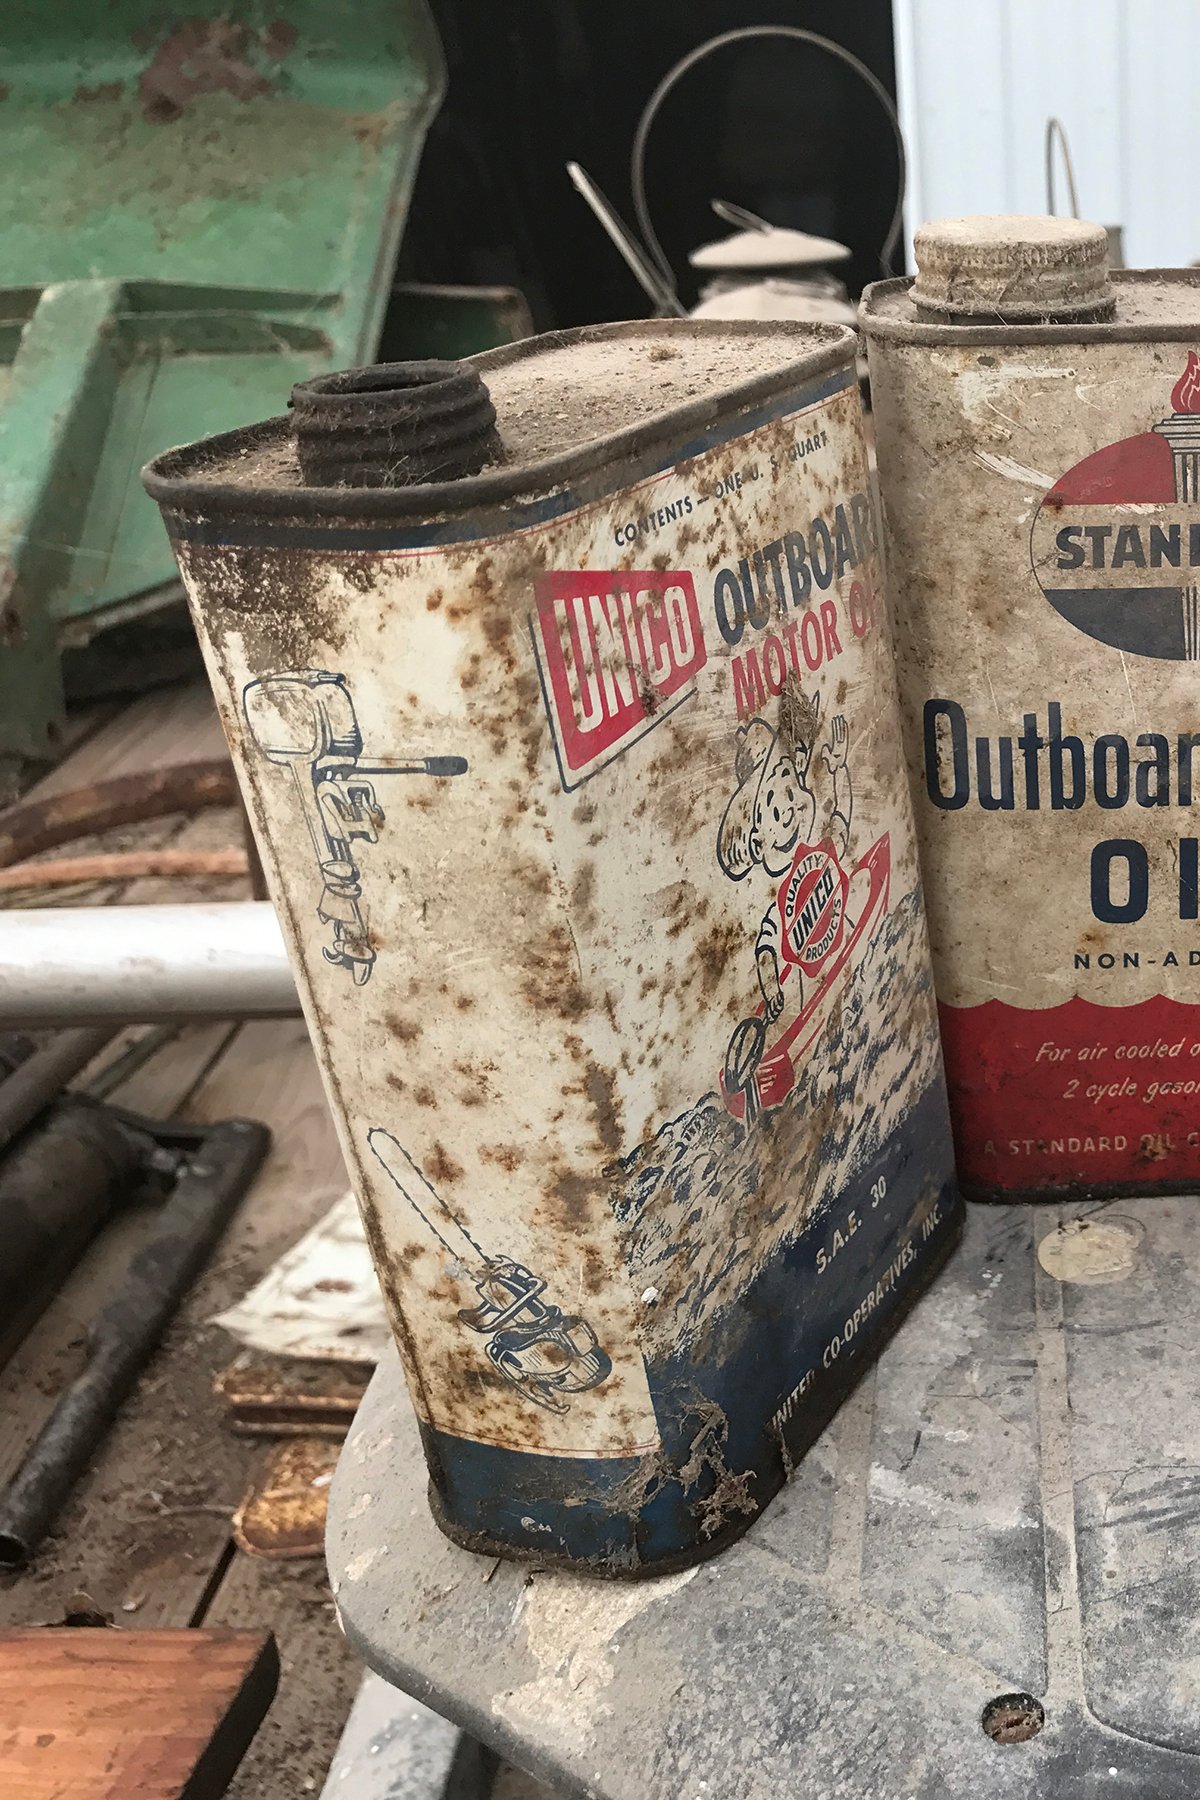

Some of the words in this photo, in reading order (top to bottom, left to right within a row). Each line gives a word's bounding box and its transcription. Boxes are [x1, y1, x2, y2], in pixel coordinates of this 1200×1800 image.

[614, 496, 693, 547] CONTENTS
[715, 472, 742, 499] ONE
[789, 430, 828, 462] QUART
[713, 492, 880, 645] OUTBOAR
[552, 584, 696, 734] UNICO
[731, 600, 843, 720] MOTOR
[785, 853, 823, 918] QUALITY
[792, 866, 835, 951] UNICO
[806, 898, 841, 961] PRODUCTS
[1035, 1041, 1070, 1063] For
[1078, 1042, 1107, 1060] air
[1114, 1037, 1186, 1060] cooled
[1062, 1079, 1079, 1099] 2
[1084, 1078, 1138, 1105] cycle
[983, 1140, 997, 1156] A
[1008, 1135, 1128, 1156] STANDARD
[871, 1176, 887, 1208] 30
[922, 1203, 943, 1241] INC.
